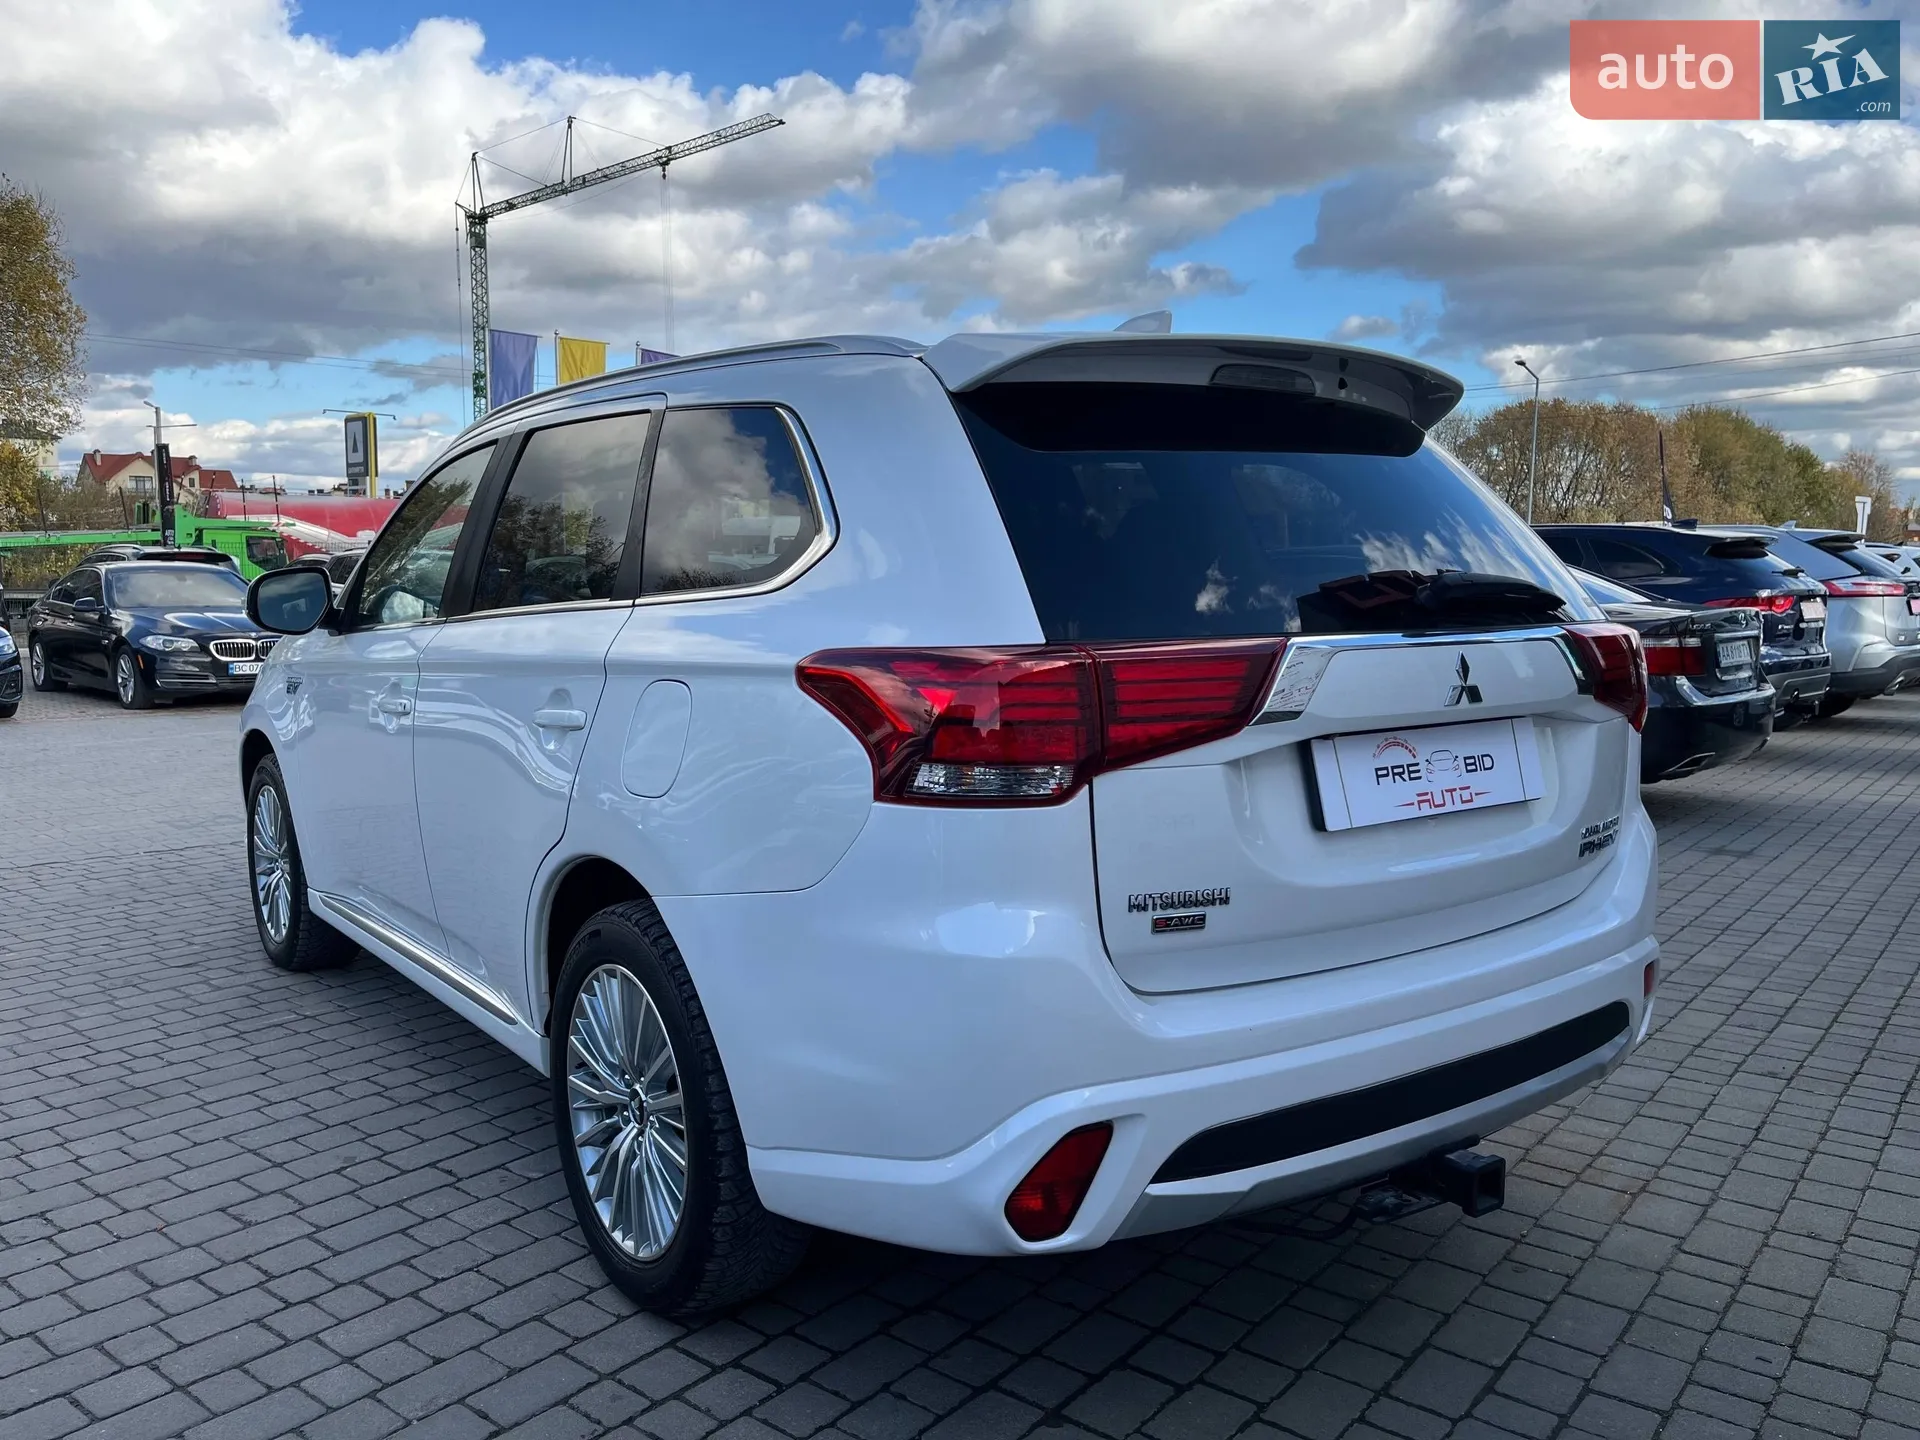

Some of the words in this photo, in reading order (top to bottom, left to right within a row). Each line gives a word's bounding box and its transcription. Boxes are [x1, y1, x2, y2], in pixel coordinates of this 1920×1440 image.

[1374, 762, 1423, 786] PRE
[1463, 753, 1495, 774] BID
[1416, 785, 1474, 811] AUTO
[1128, 887, 1231, 913] MITSUBISHI
[1155, 915, 1204, 928] S-AWC
